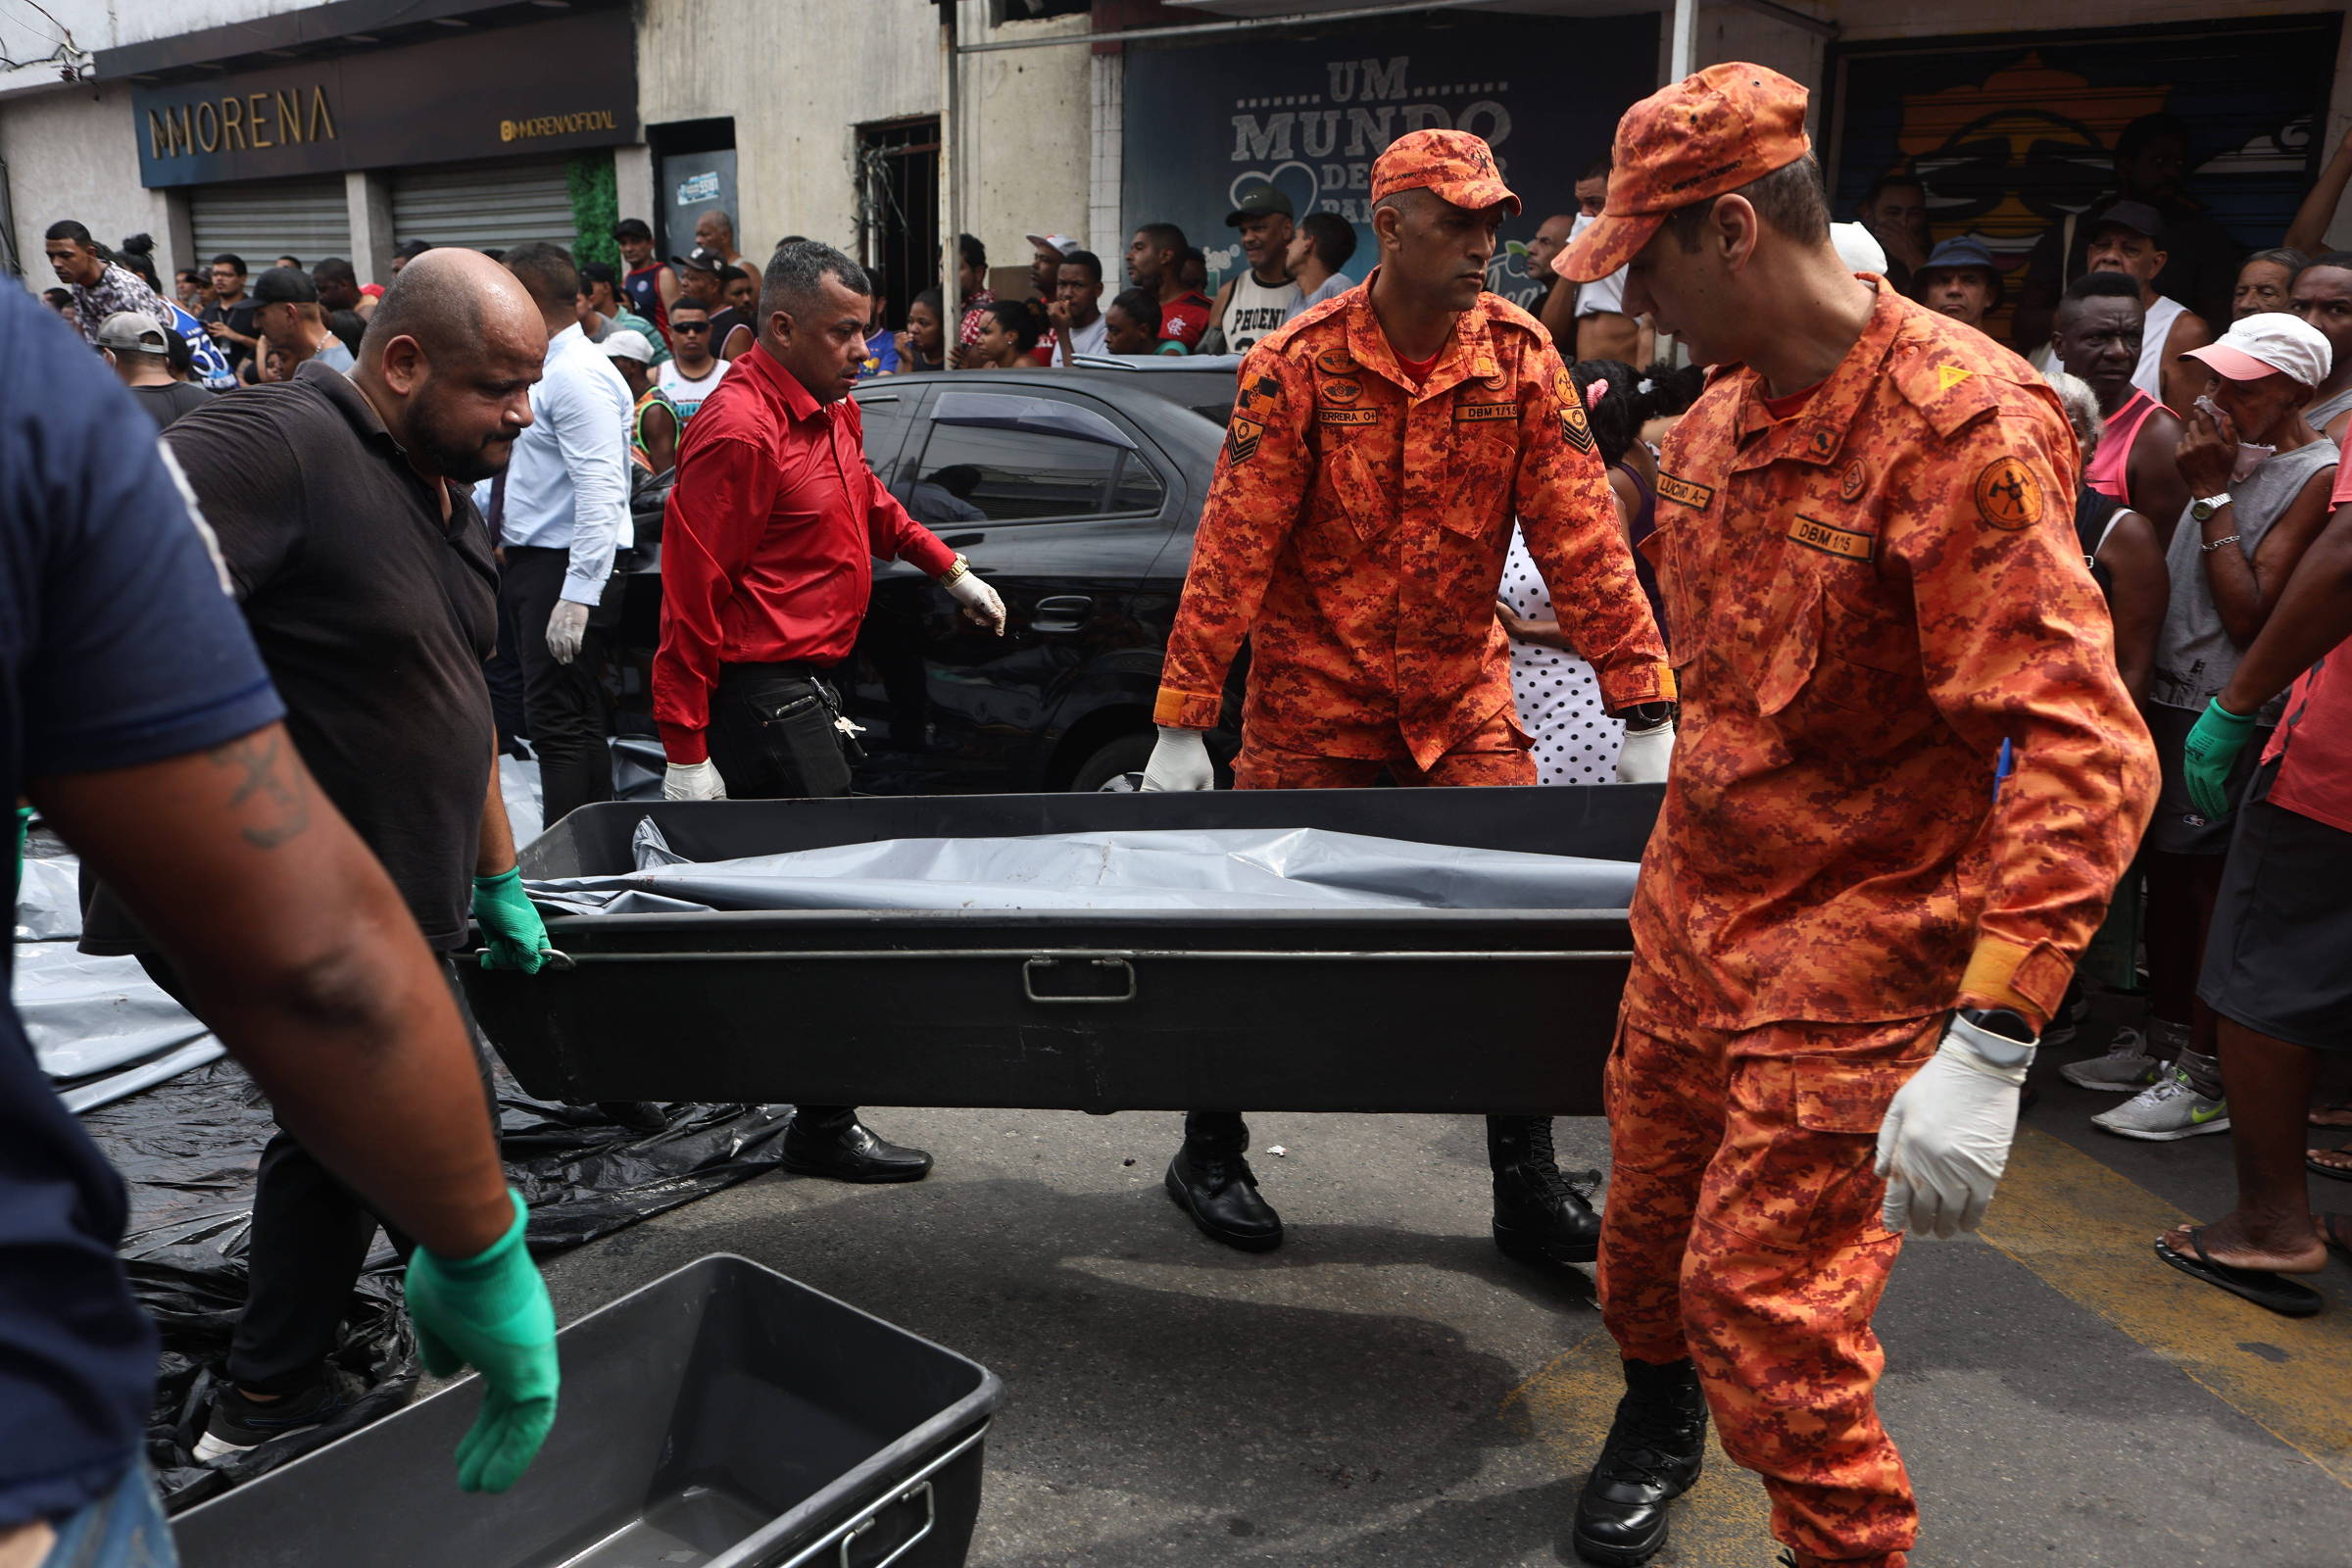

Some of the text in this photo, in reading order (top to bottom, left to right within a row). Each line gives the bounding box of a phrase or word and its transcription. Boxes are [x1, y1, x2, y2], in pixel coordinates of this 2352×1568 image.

[1327, 56, 1409, 102] UM
[1231, 100, 1512, 162] MUNDO
[1231, 307, 1288, 335] PHOENI
[185, 333, 229, 378] 33
[1468, 407, 1493, 418] DBM
[1798, 522, 1833, 546] DBM
